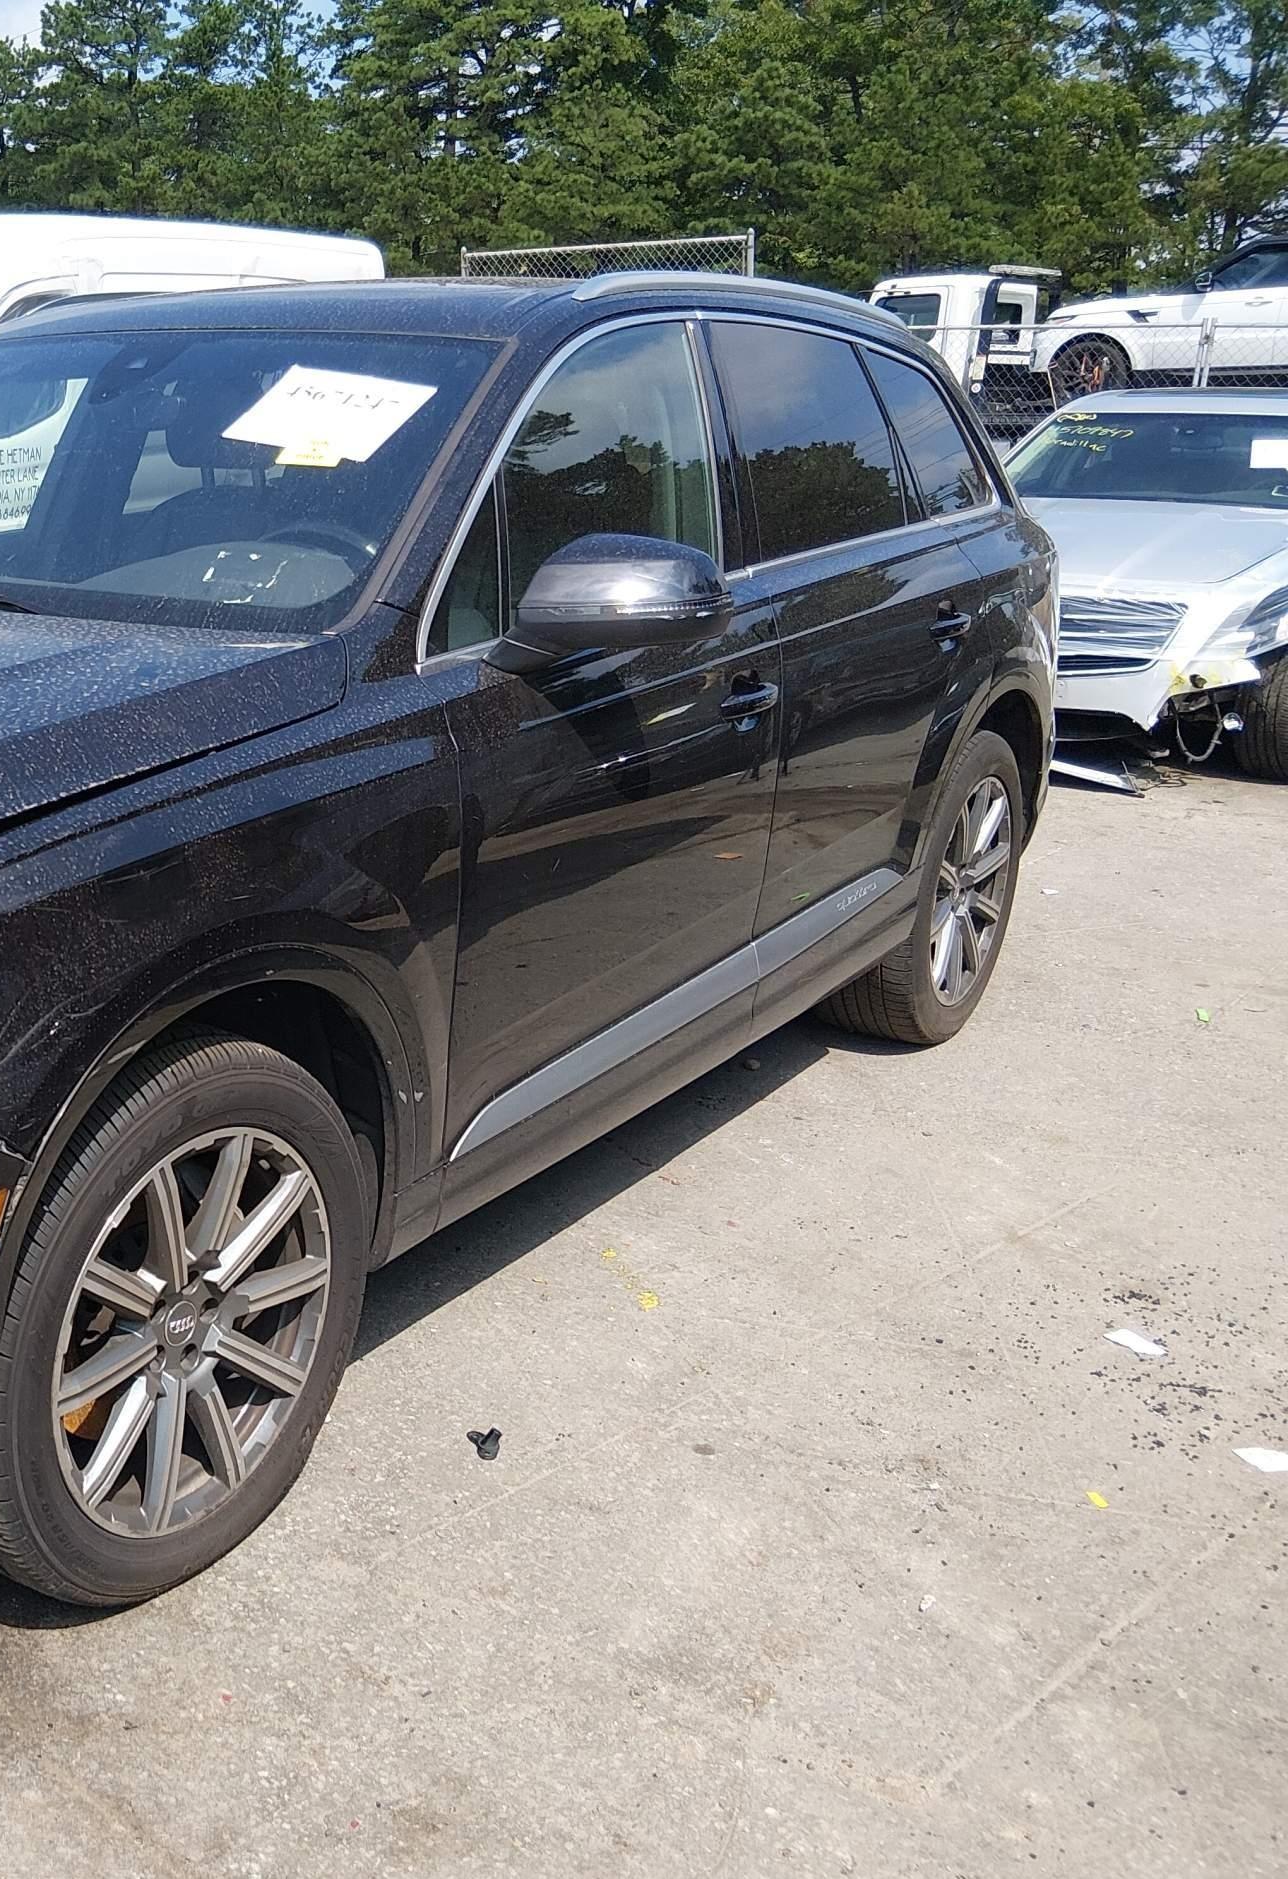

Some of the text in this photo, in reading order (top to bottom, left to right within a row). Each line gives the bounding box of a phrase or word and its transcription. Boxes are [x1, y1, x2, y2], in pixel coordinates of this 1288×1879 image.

[6, 447, 42, 464] HETMAN
[17, 465, 39, 483] LANE
[14, 486, 26, 502] NY
[27, 484, 41, 501] 117
